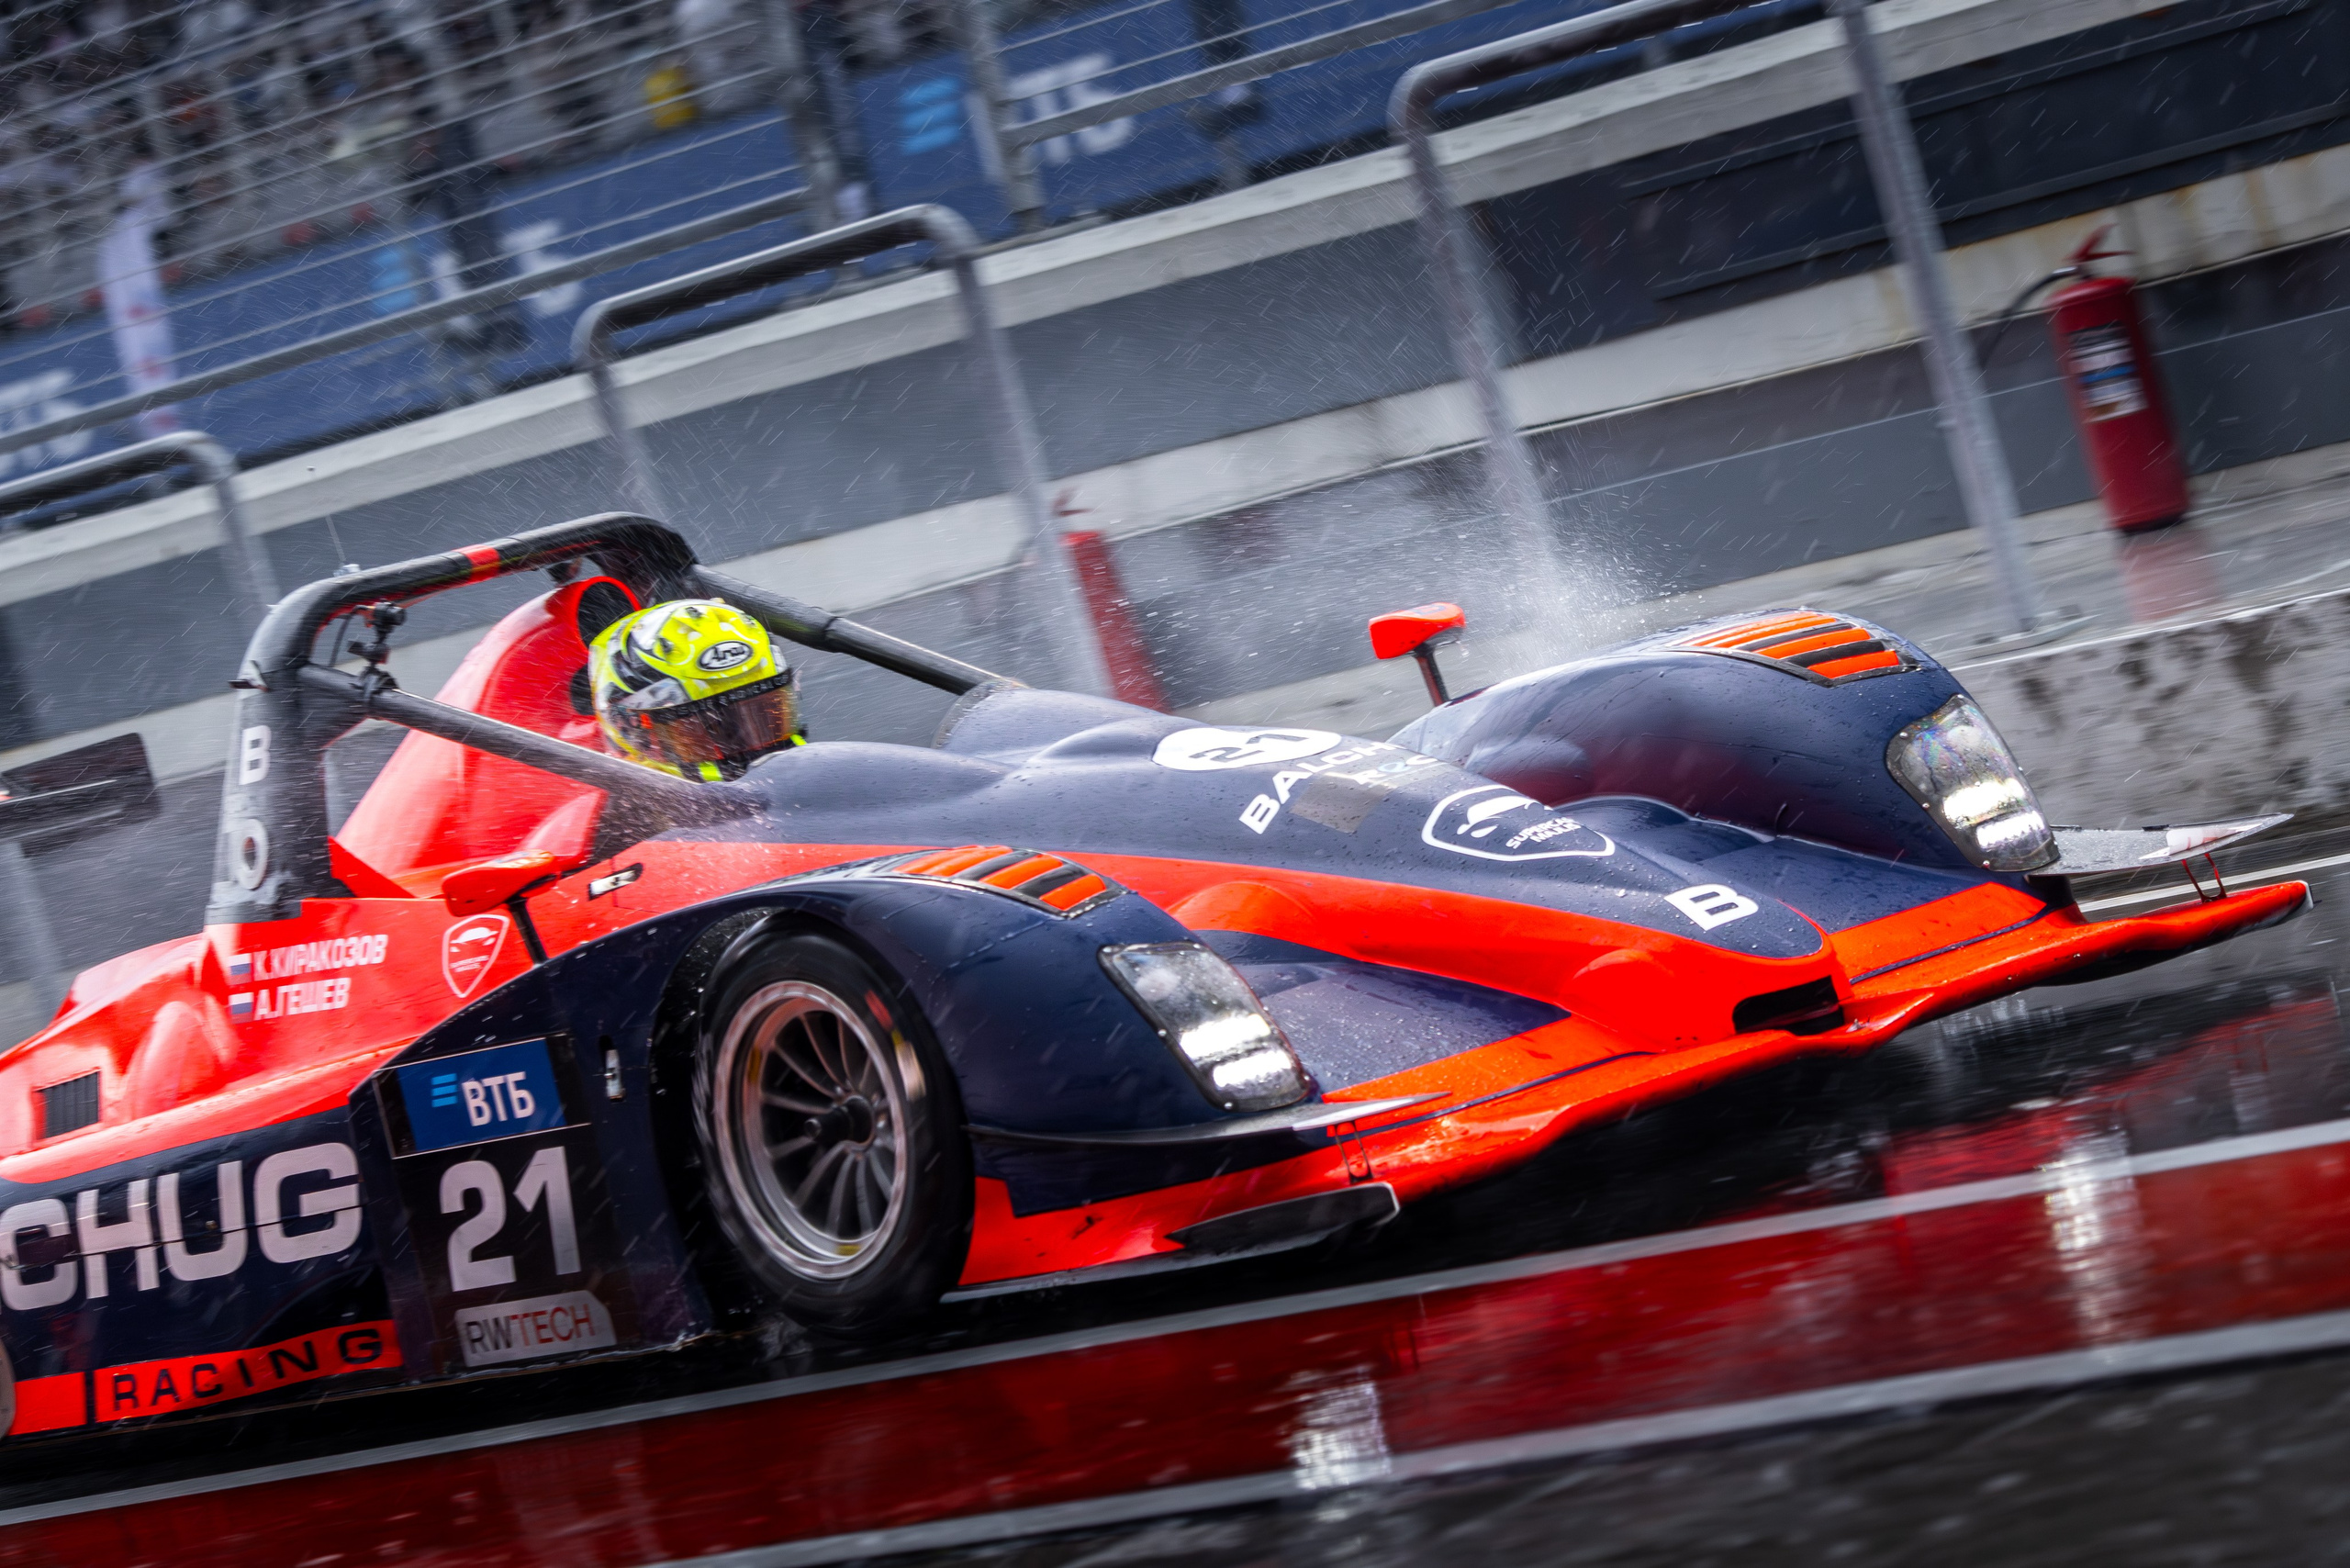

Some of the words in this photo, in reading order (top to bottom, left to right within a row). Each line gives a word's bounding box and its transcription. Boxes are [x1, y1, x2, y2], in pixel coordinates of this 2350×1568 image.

[239, 725, 272, 785] B
[1188, 733, 1310, 763] 21
[1663, 884, 1759, 931] B
[462, 1070, 535, 1127] ВТБ
[440, 1146, 582, 1292] 21
[465, 1304, 596, 1354] RWTECH
[113, 1327, 384, 1411] RACING
